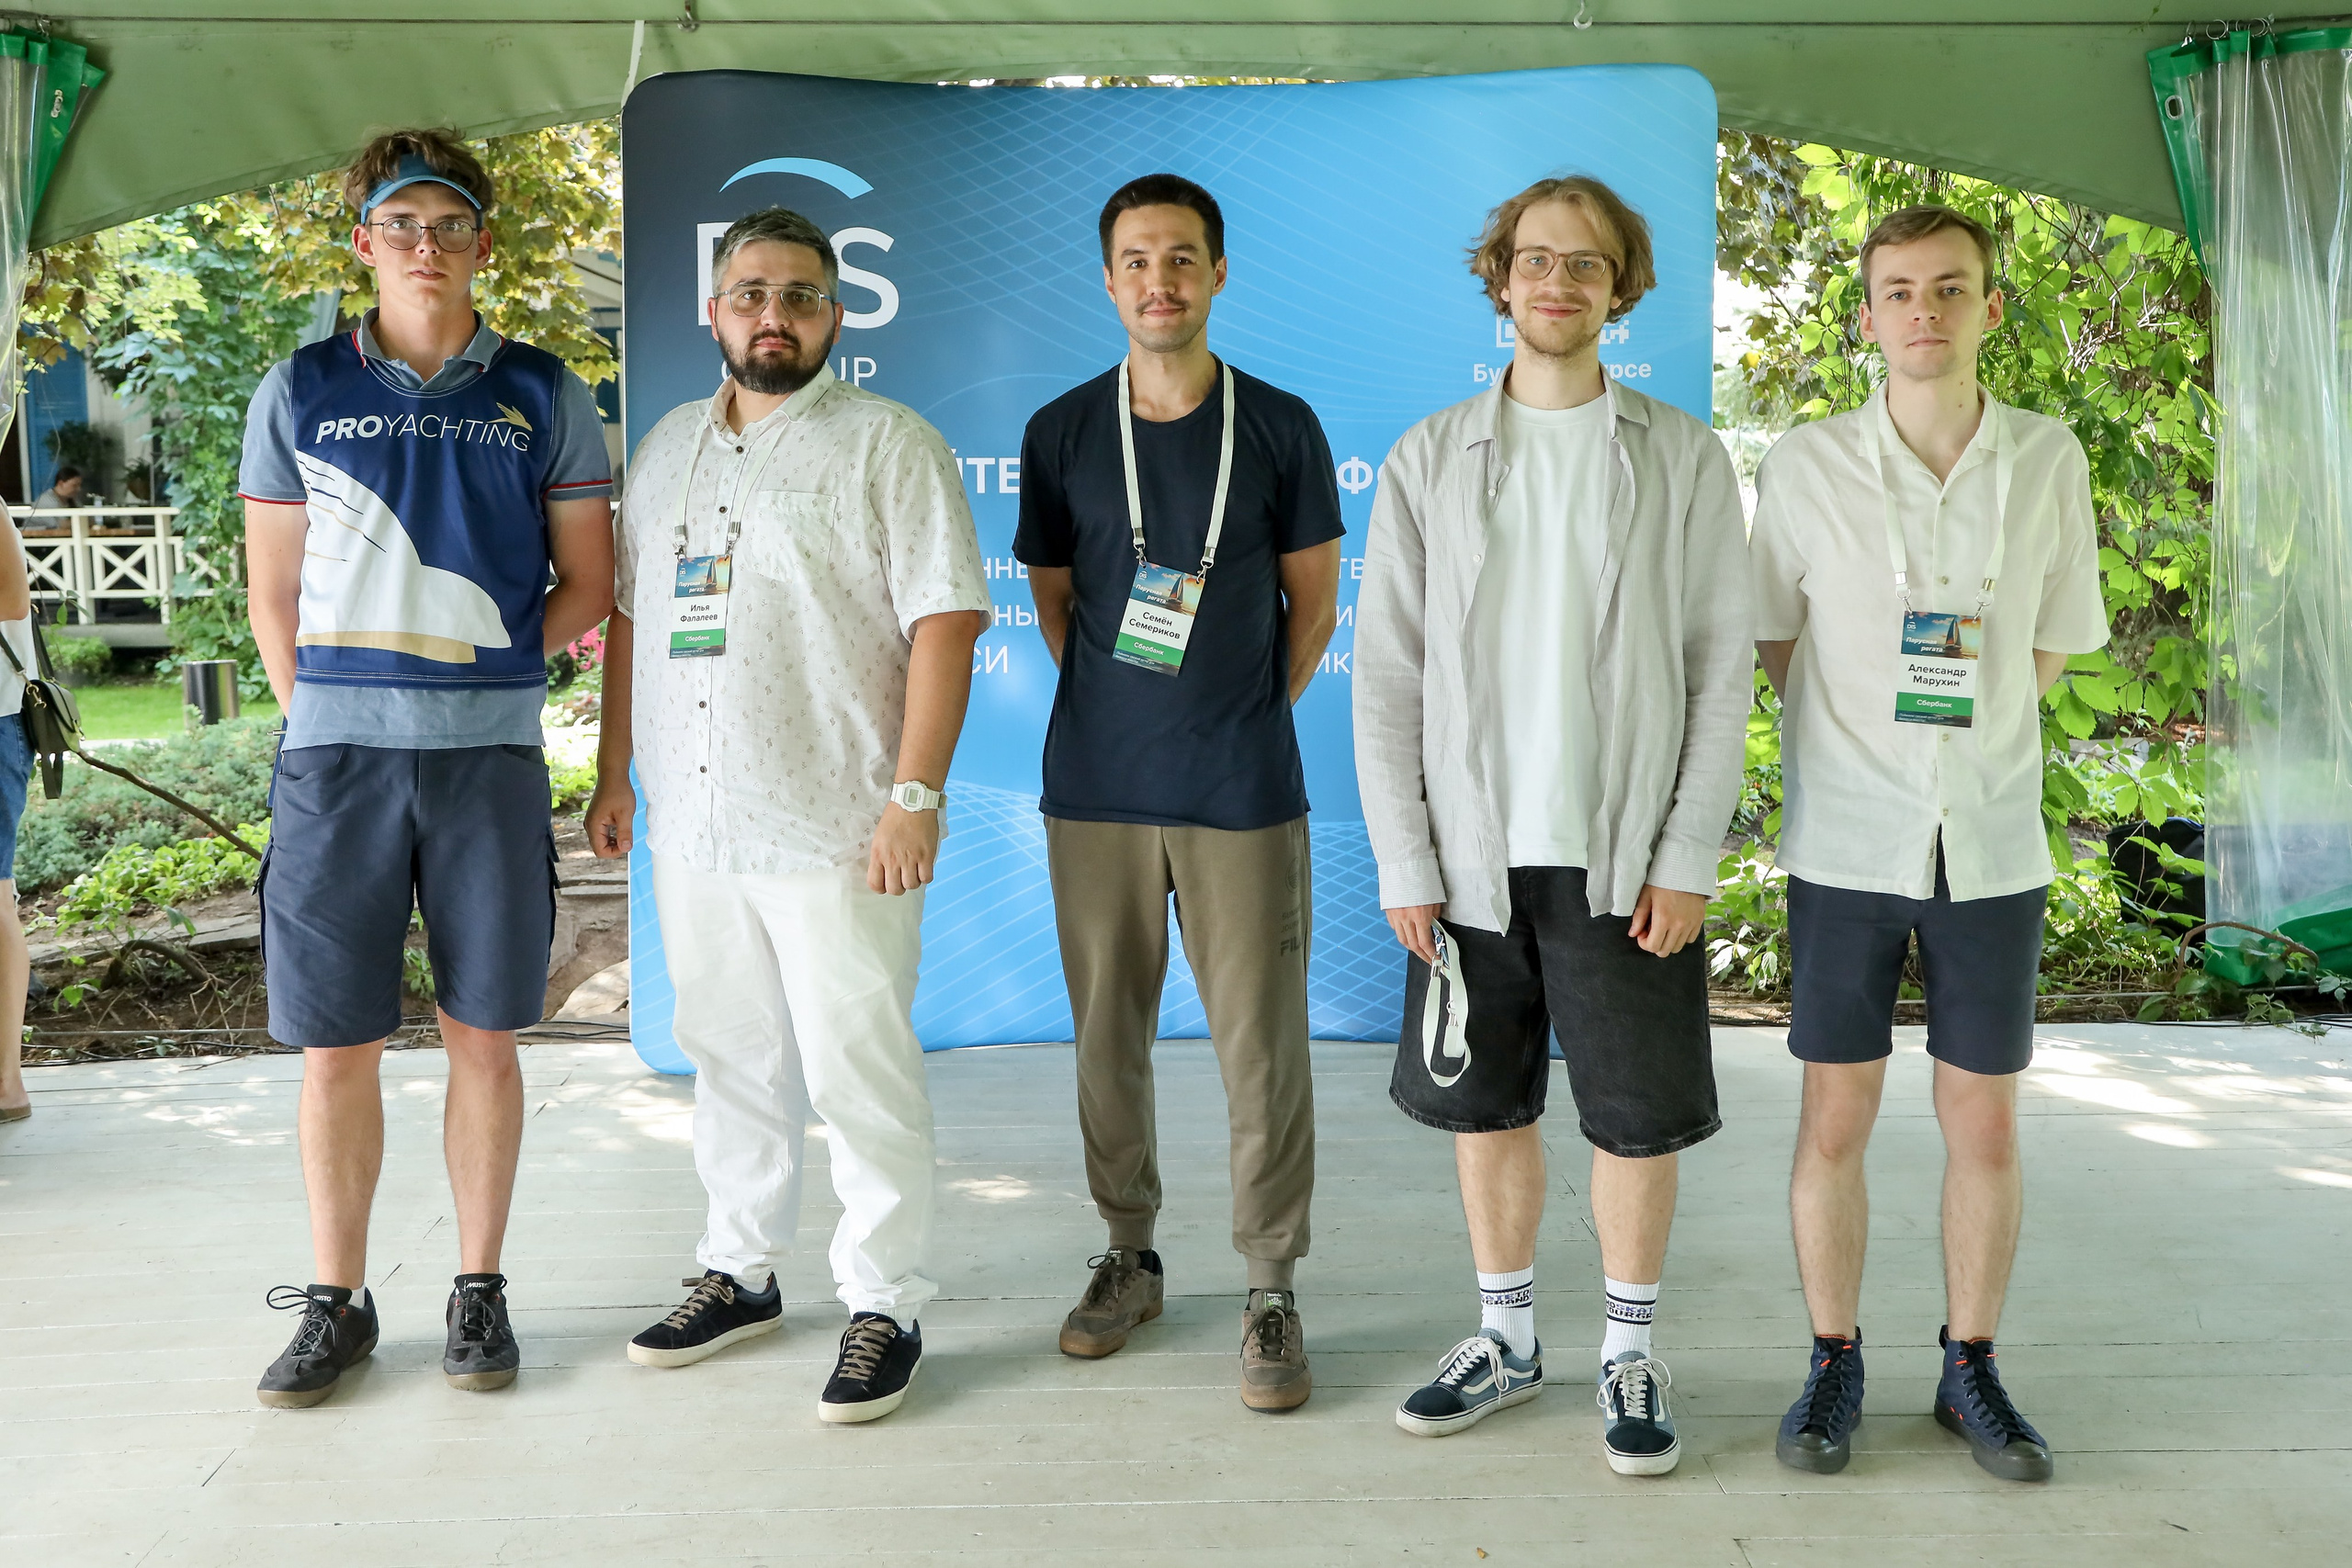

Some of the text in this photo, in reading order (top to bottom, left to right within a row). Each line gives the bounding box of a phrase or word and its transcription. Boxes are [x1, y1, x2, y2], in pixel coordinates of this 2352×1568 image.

[315, 413, 530, 451] PROYACHTING
[1136, 583, 1163, 596] Парусная
[1147, 594, 1167, 604] регата
[690, 604, 710, 613] Илья
[680, 614, 718, 623] Фалалеев
[1142, 611, 1172, 626] Семён
[1129, 618, 1181, 639] Семериков
[684, 635, 710, 643] Сбербанк
[1905, 637, 1938, 645] Парусная
[1134, 642, 1164, 656] Сбербанк
[1908, 663, 1967, 677] Александр
[1913, 675, 1961, 687] Марухин
[1917, 699, 1952, 708] Сбербанк
